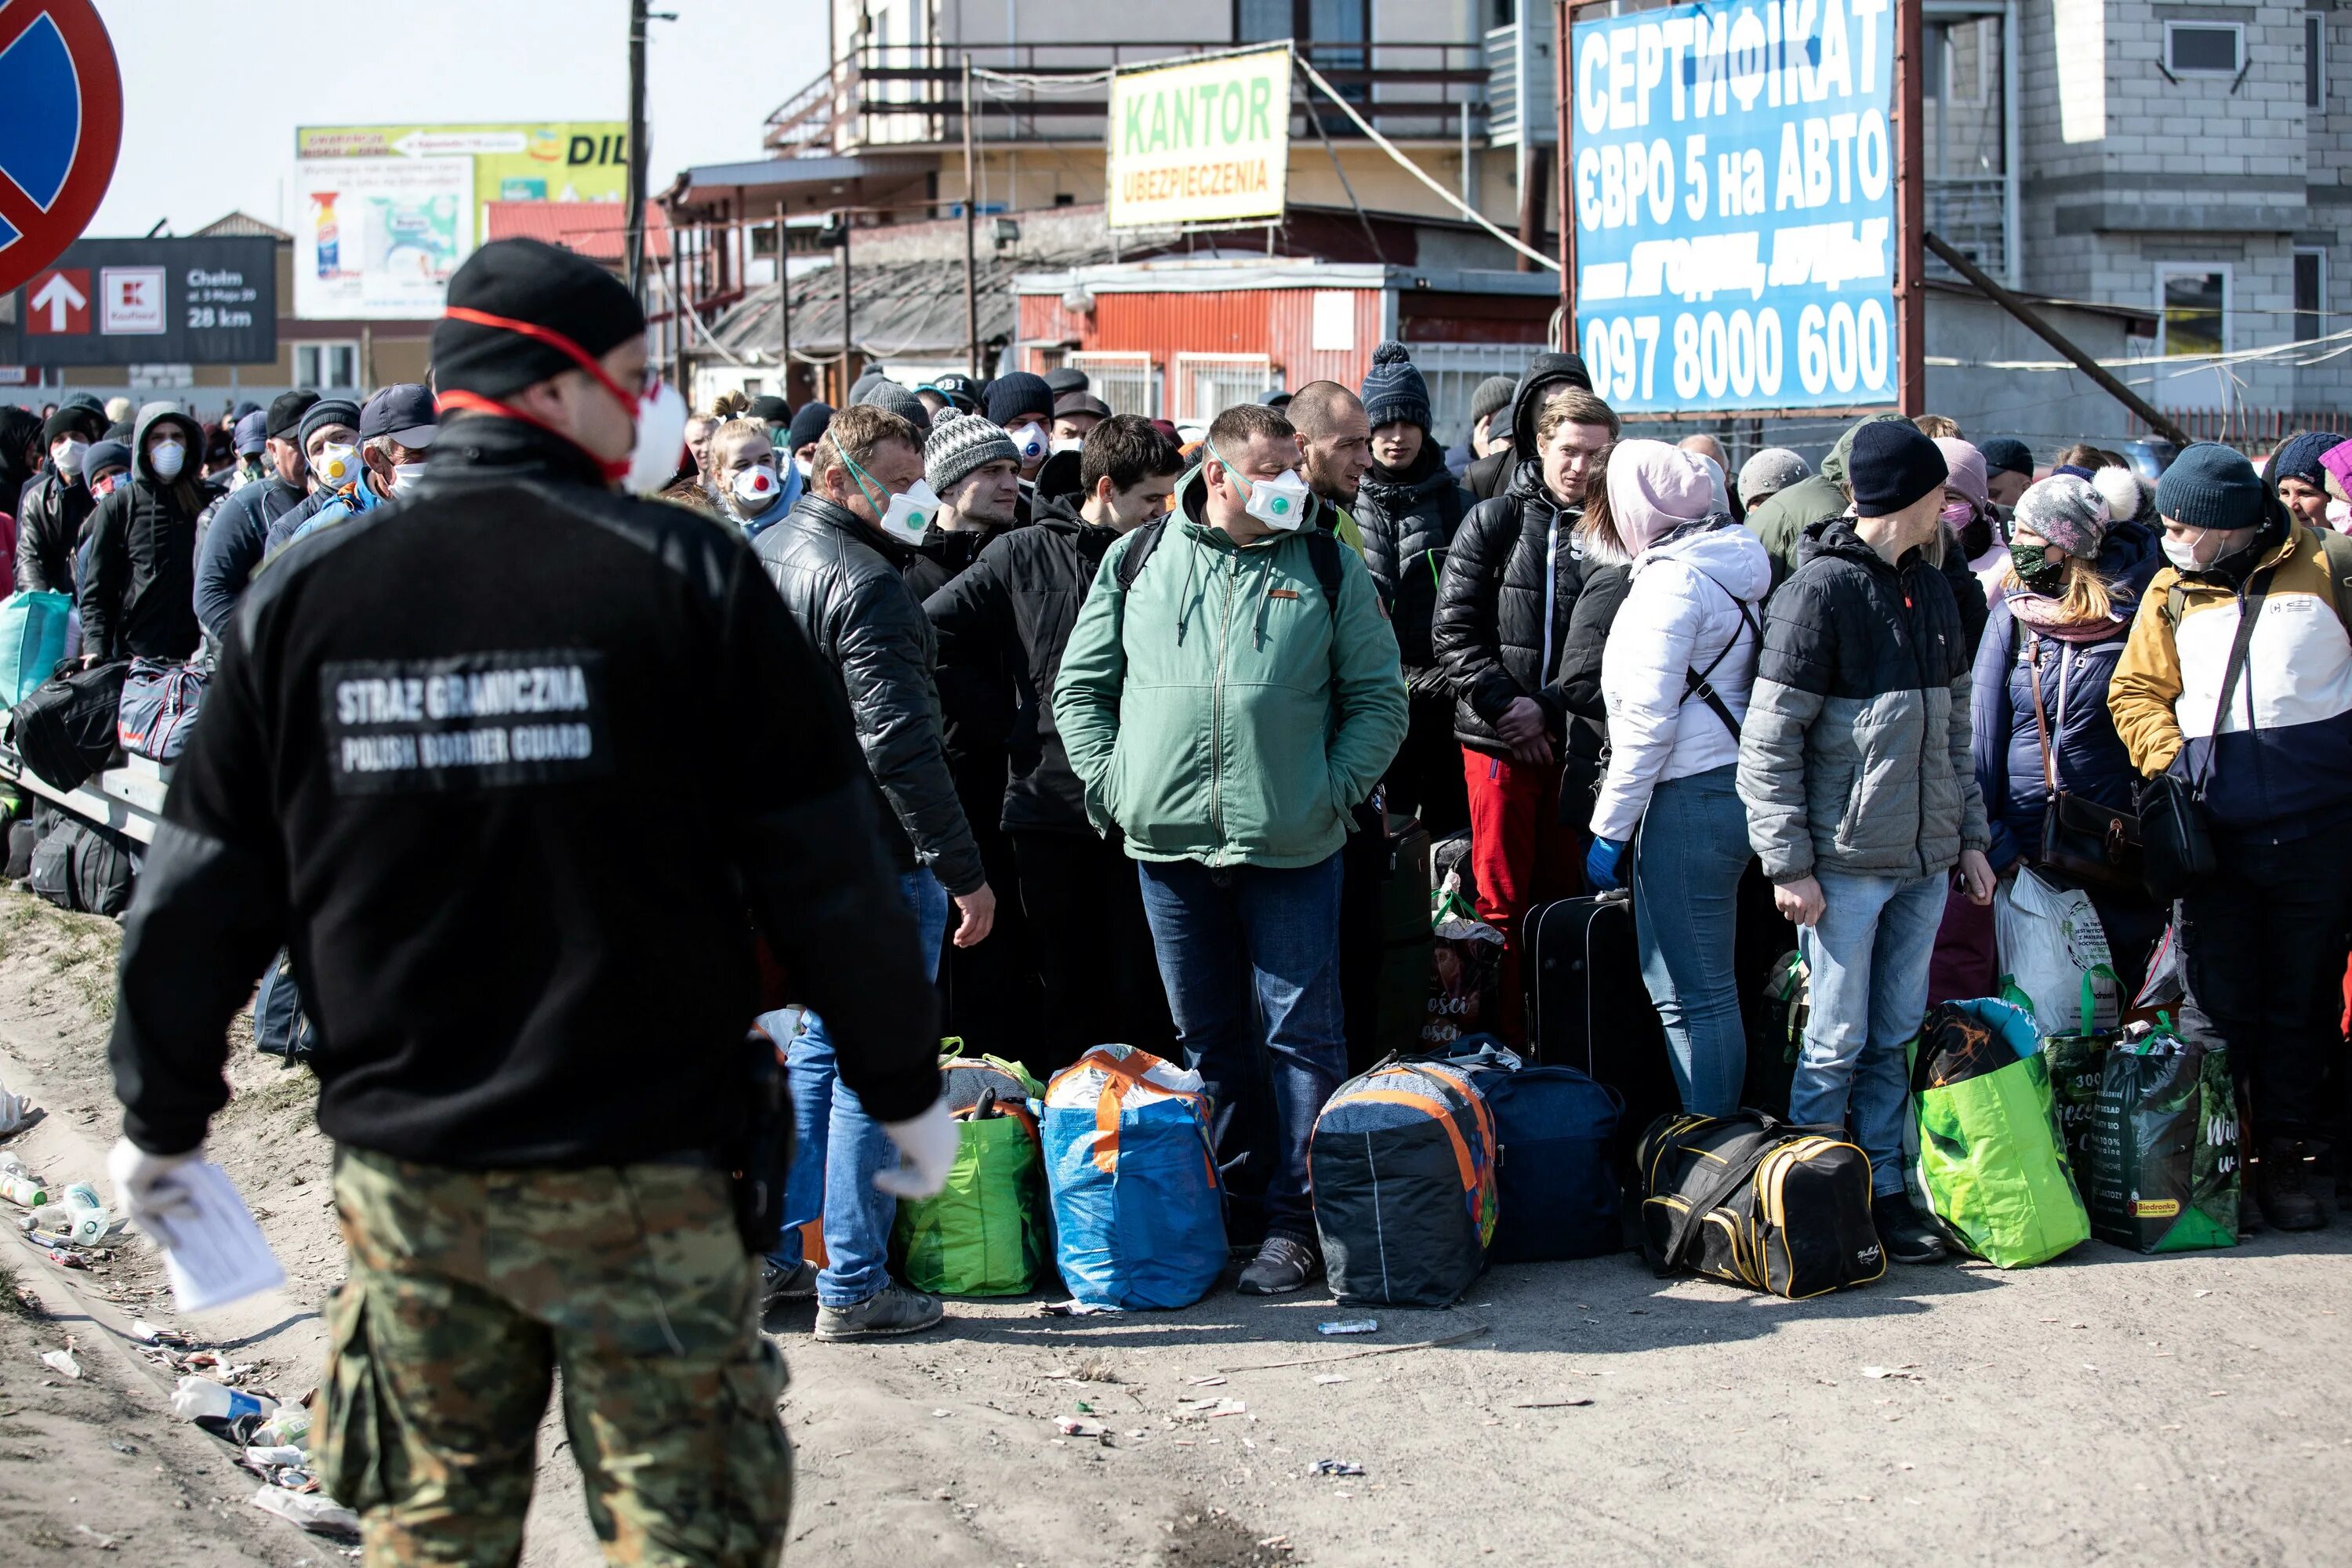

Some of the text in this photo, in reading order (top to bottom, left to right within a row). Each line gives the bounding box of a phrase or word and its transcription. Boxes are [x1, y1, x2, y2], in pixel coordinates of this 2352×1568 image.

[1124, 75, 1272, 155] KANTOR
[1122, 159, 1269, 204] UBEZPIECZENIA
[1577, 108, 1889, 231] ЄВРО 5 на АВТО
[187, 307, 252, 328] 28 km
[1585, 298, 1888, 401] 097 8000 600
[426, 665, 589, 720] GRANICZNA
[341, 723, 592, 773] POLISH BORDER GUARD
